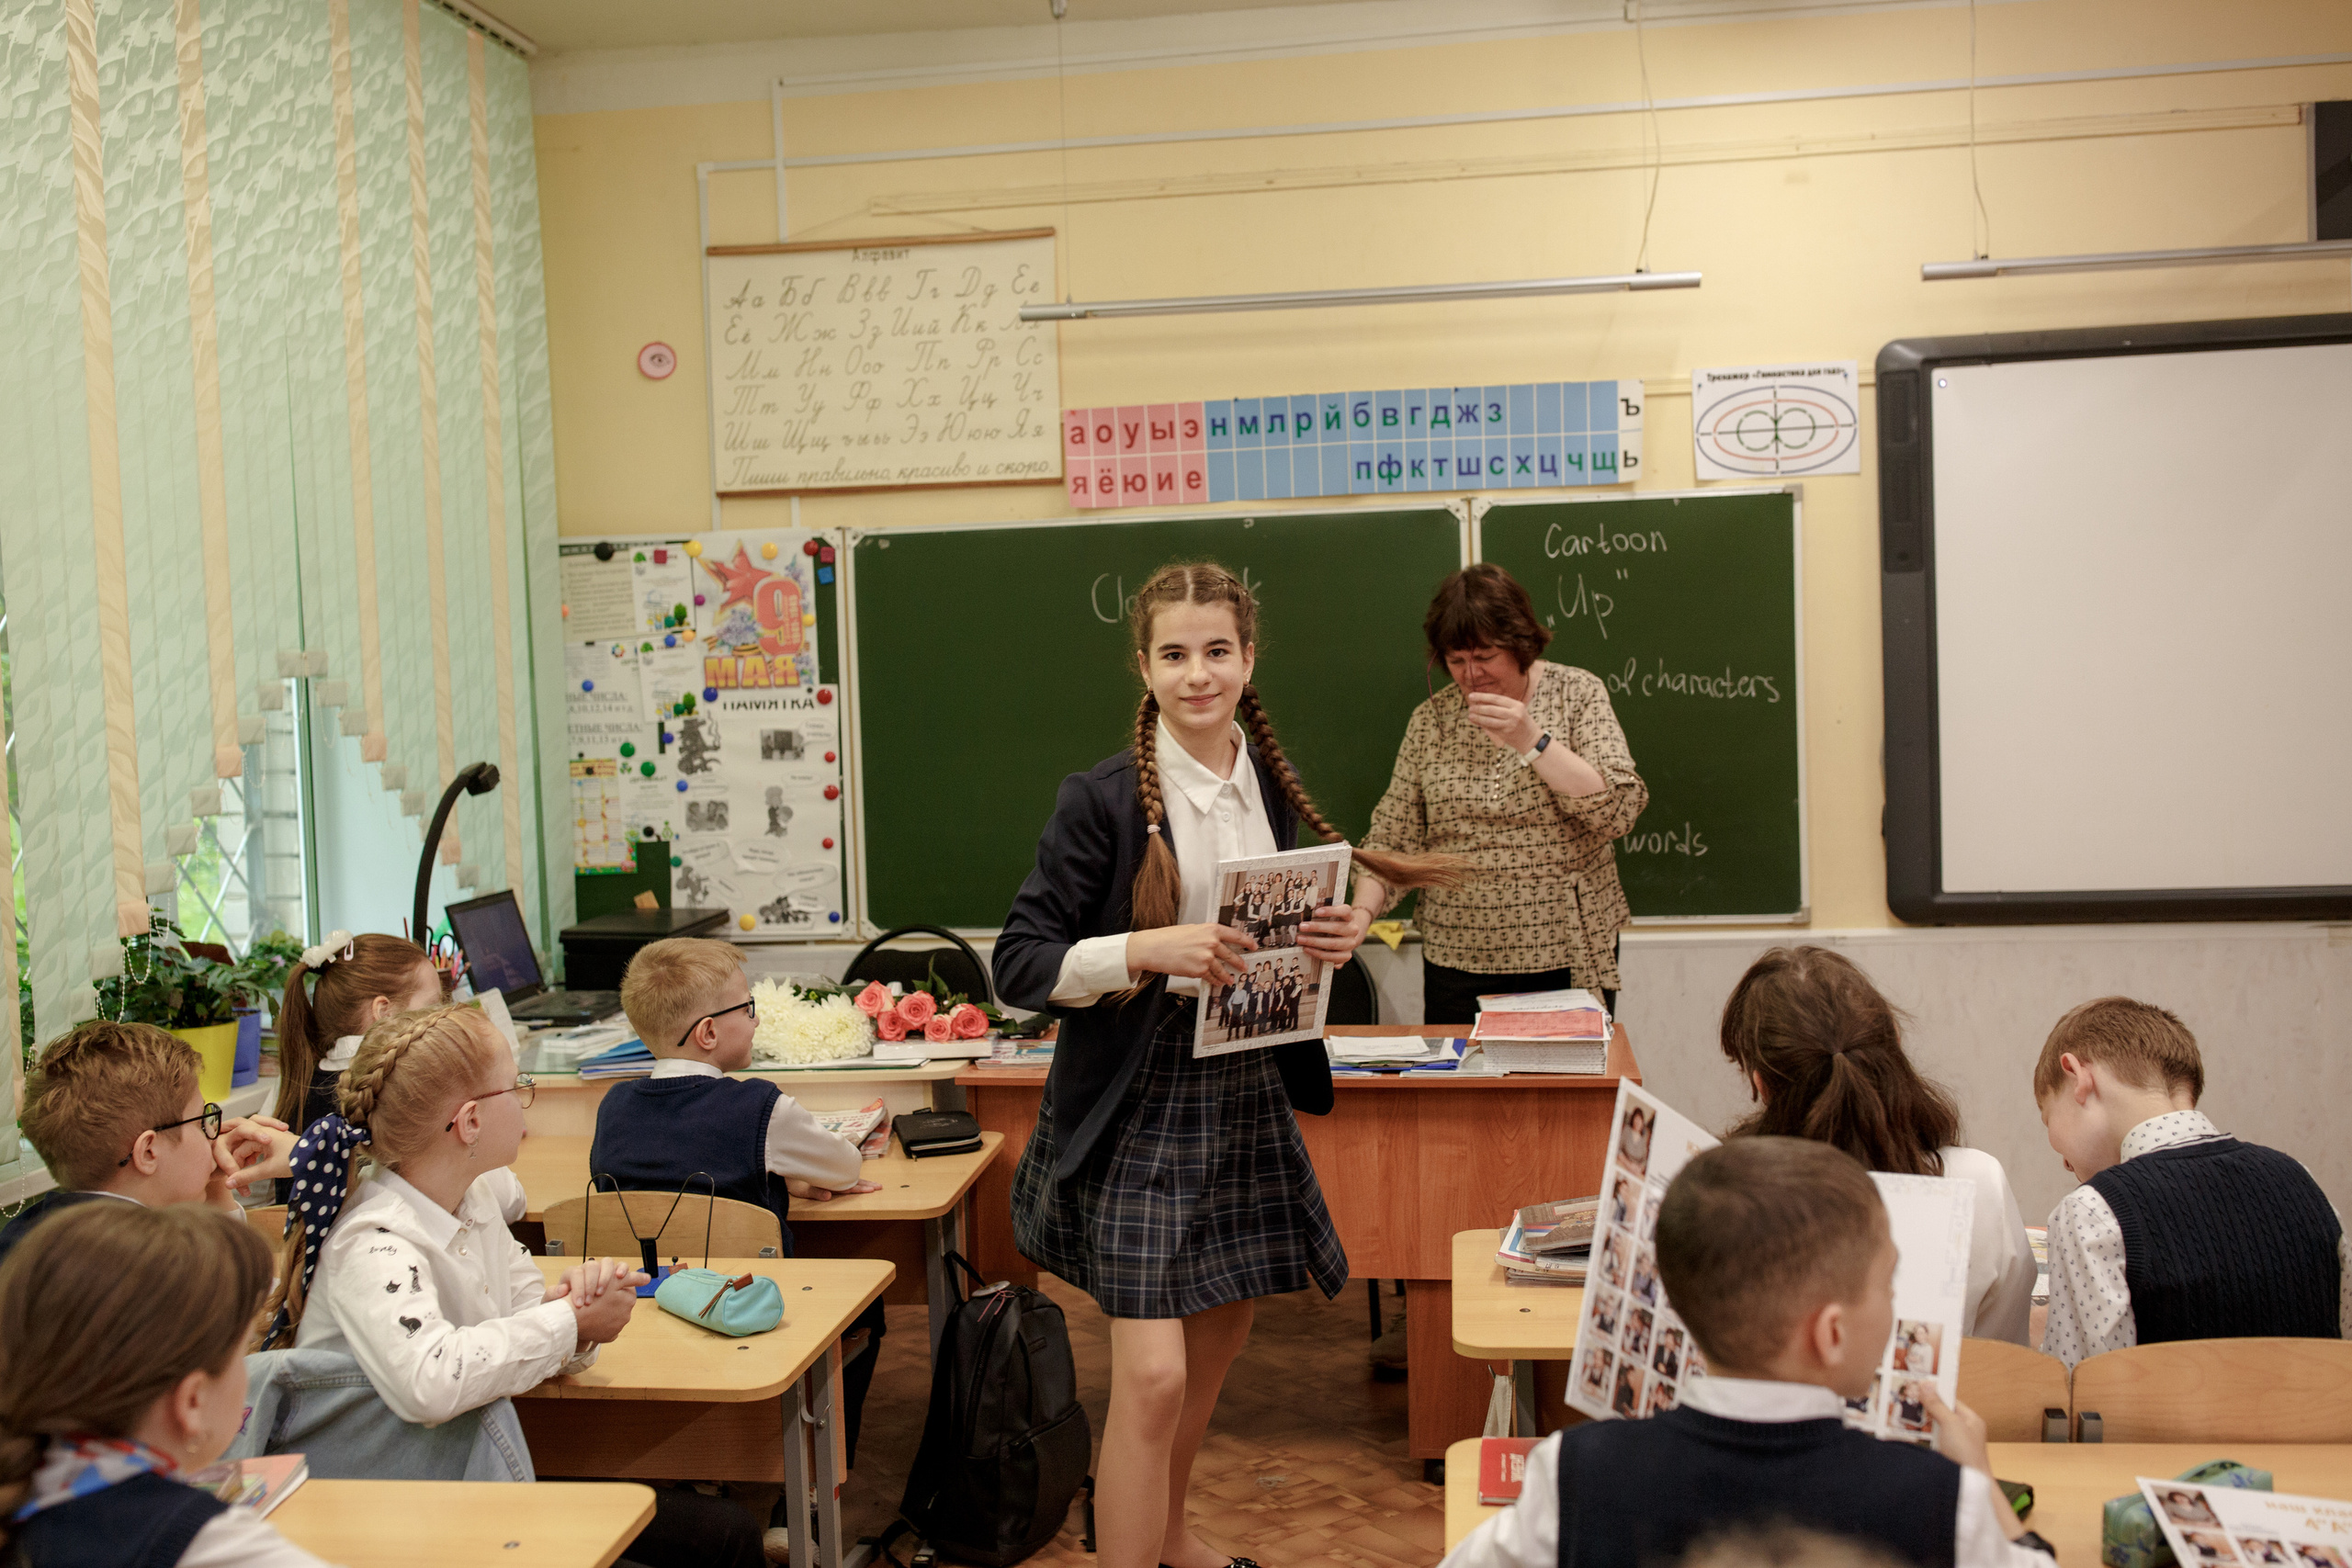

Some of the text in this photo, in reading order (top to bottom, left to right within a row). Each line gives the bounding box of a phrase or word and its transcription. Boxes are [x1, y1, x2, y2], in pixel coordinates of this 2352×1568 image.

[852, 248, 910, 265] Алфавит
[724, 456, 790, 486] Пиши
[897, 451, 971, 485] красиво
[977, 465, 991, 476] и
[1544, 522, 1668, 558] Cartoon
[754, 576, 806, 657] 9
[705, 654, 800, 689] МАЯ
[1642, 658, 1781, 703] characters
[1623, 821, 1709, 857] words
